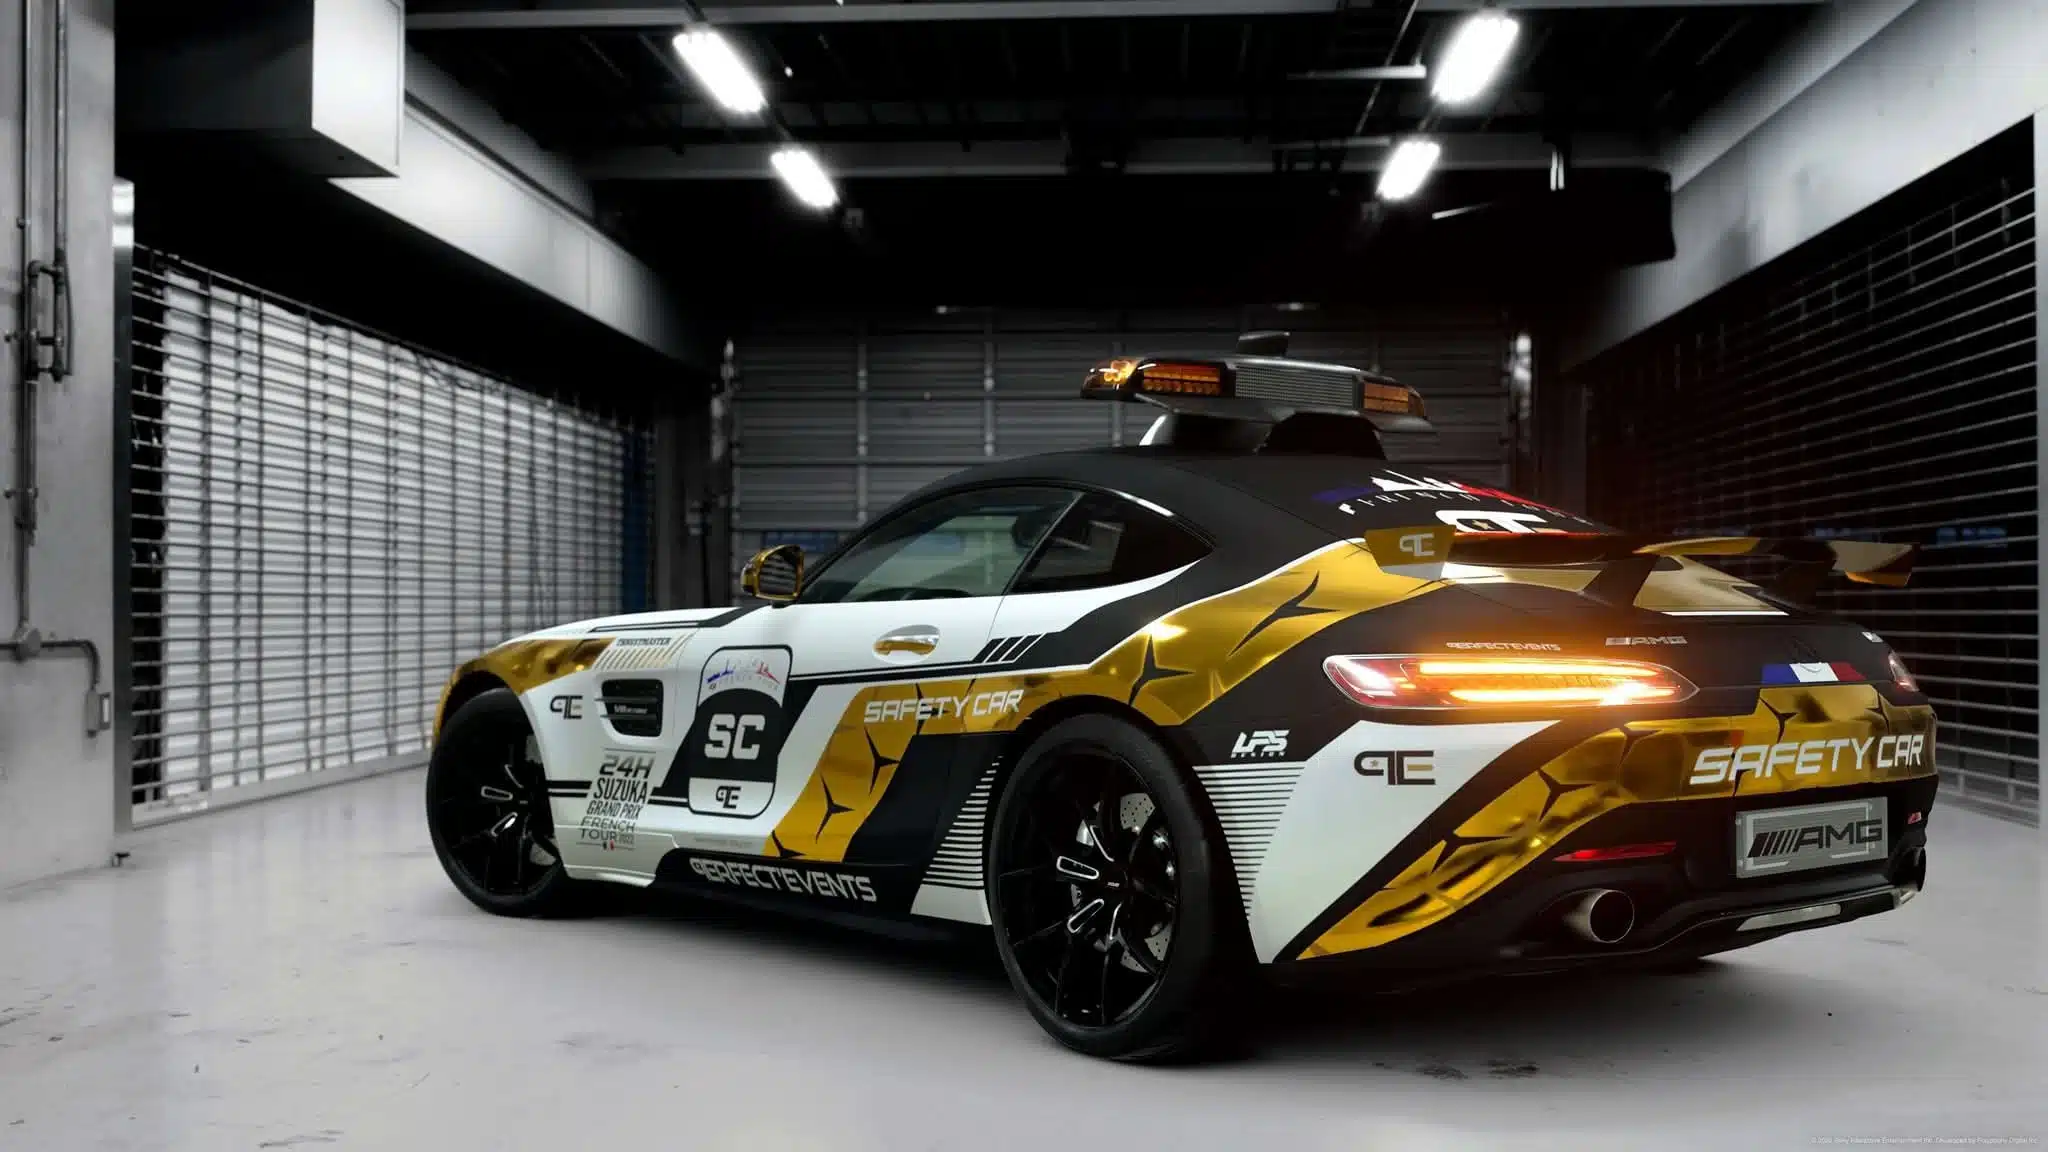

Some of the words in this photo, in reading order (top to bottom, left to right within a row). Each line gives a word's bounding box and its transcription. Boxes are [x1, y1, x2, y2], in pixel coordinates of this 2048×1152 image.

[864, 695, 969, 724] SAFETY
[971, 689, 1024, 717] CAR
[704, 713, 766, 760] SC
[599, 755, 654, 779] 24H
[1689, 736, 1874, 785] SAFETY
[1876, 734, 1924, 769] CAR
[593, 777, 648, 804] SUZUKA
[586, 800, 621, 818] GRAND
[620, 804, 643, 818] PRIX
[580, 816, 636, 833] FRENCH
[580, 828, 617, 843] TOUR
[1796, 819, 1883, 849] AMG
